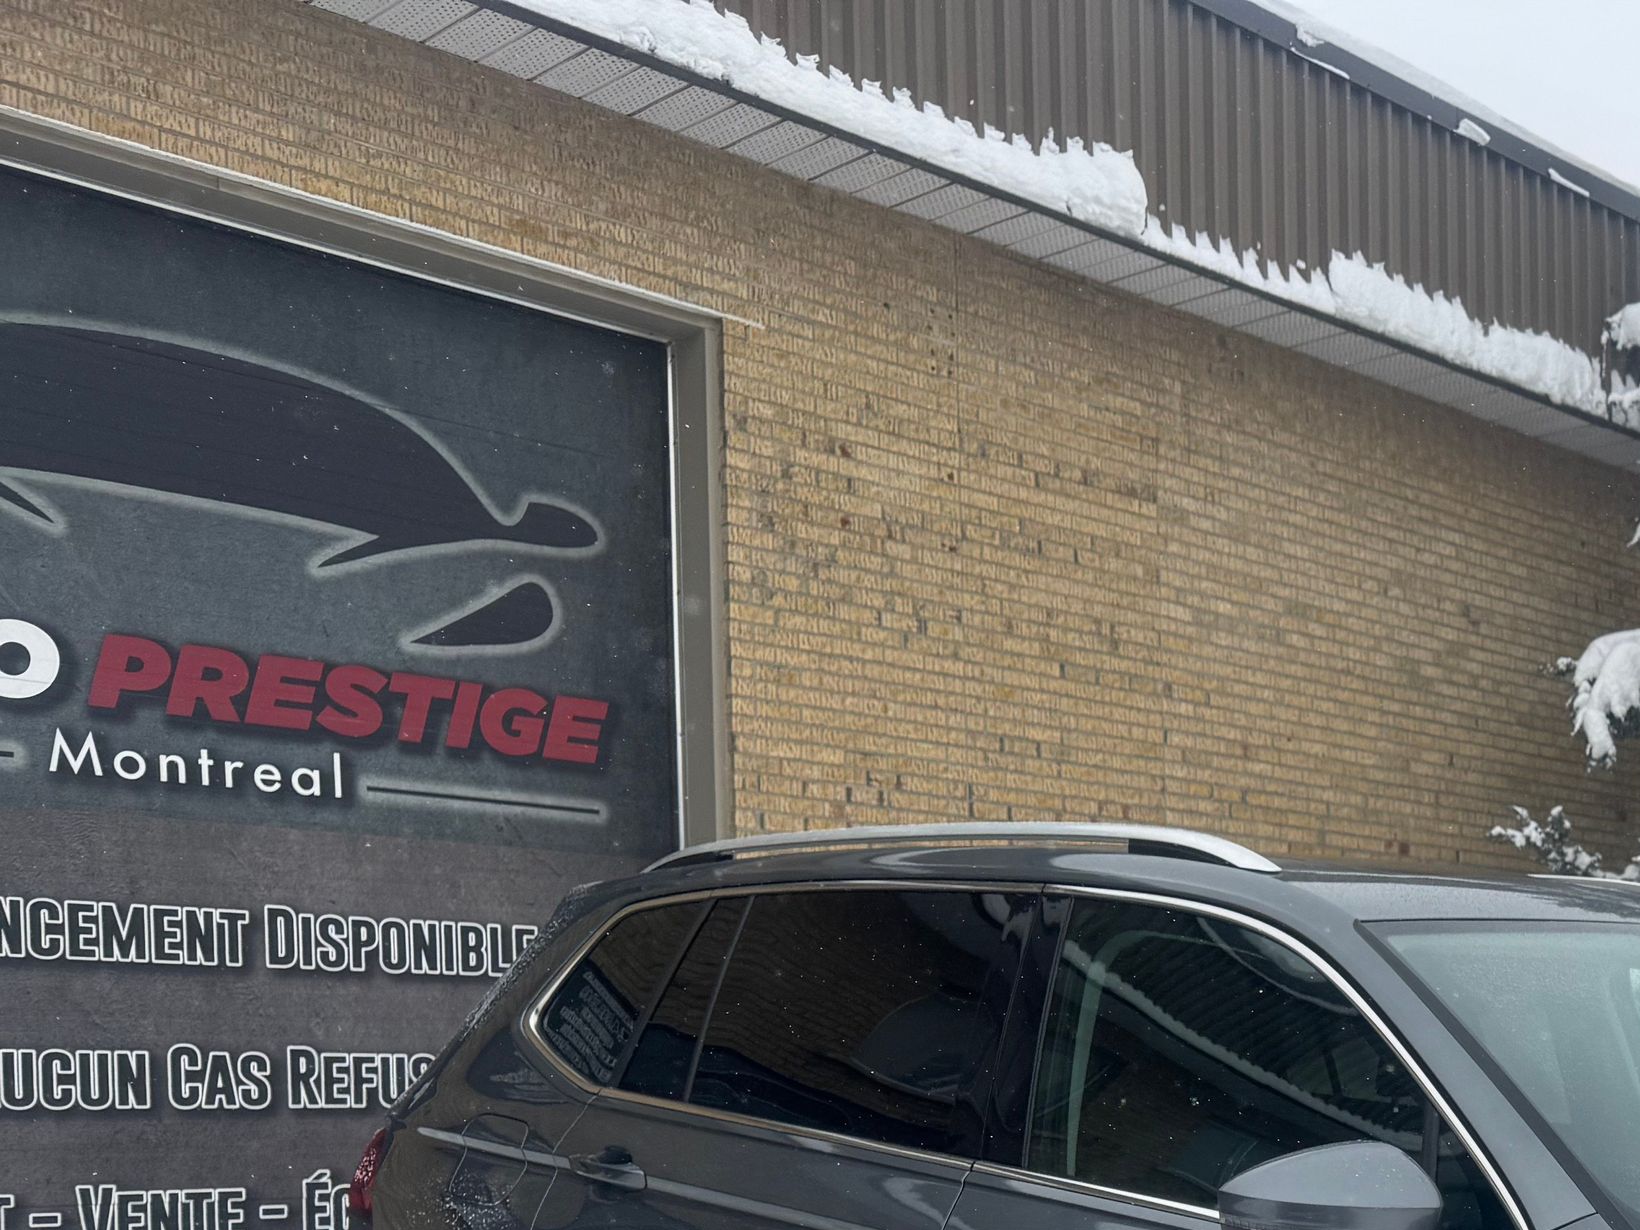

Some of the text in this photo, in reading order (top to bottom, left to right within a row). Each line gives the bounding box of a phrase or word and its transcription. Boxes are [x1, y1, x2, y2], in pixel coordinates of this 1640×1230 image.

[87, 633, 608, 764] PRESTIGE
[49, 727, 344, 799] Montreal
[167, 1043, 272, 1110] CAS
